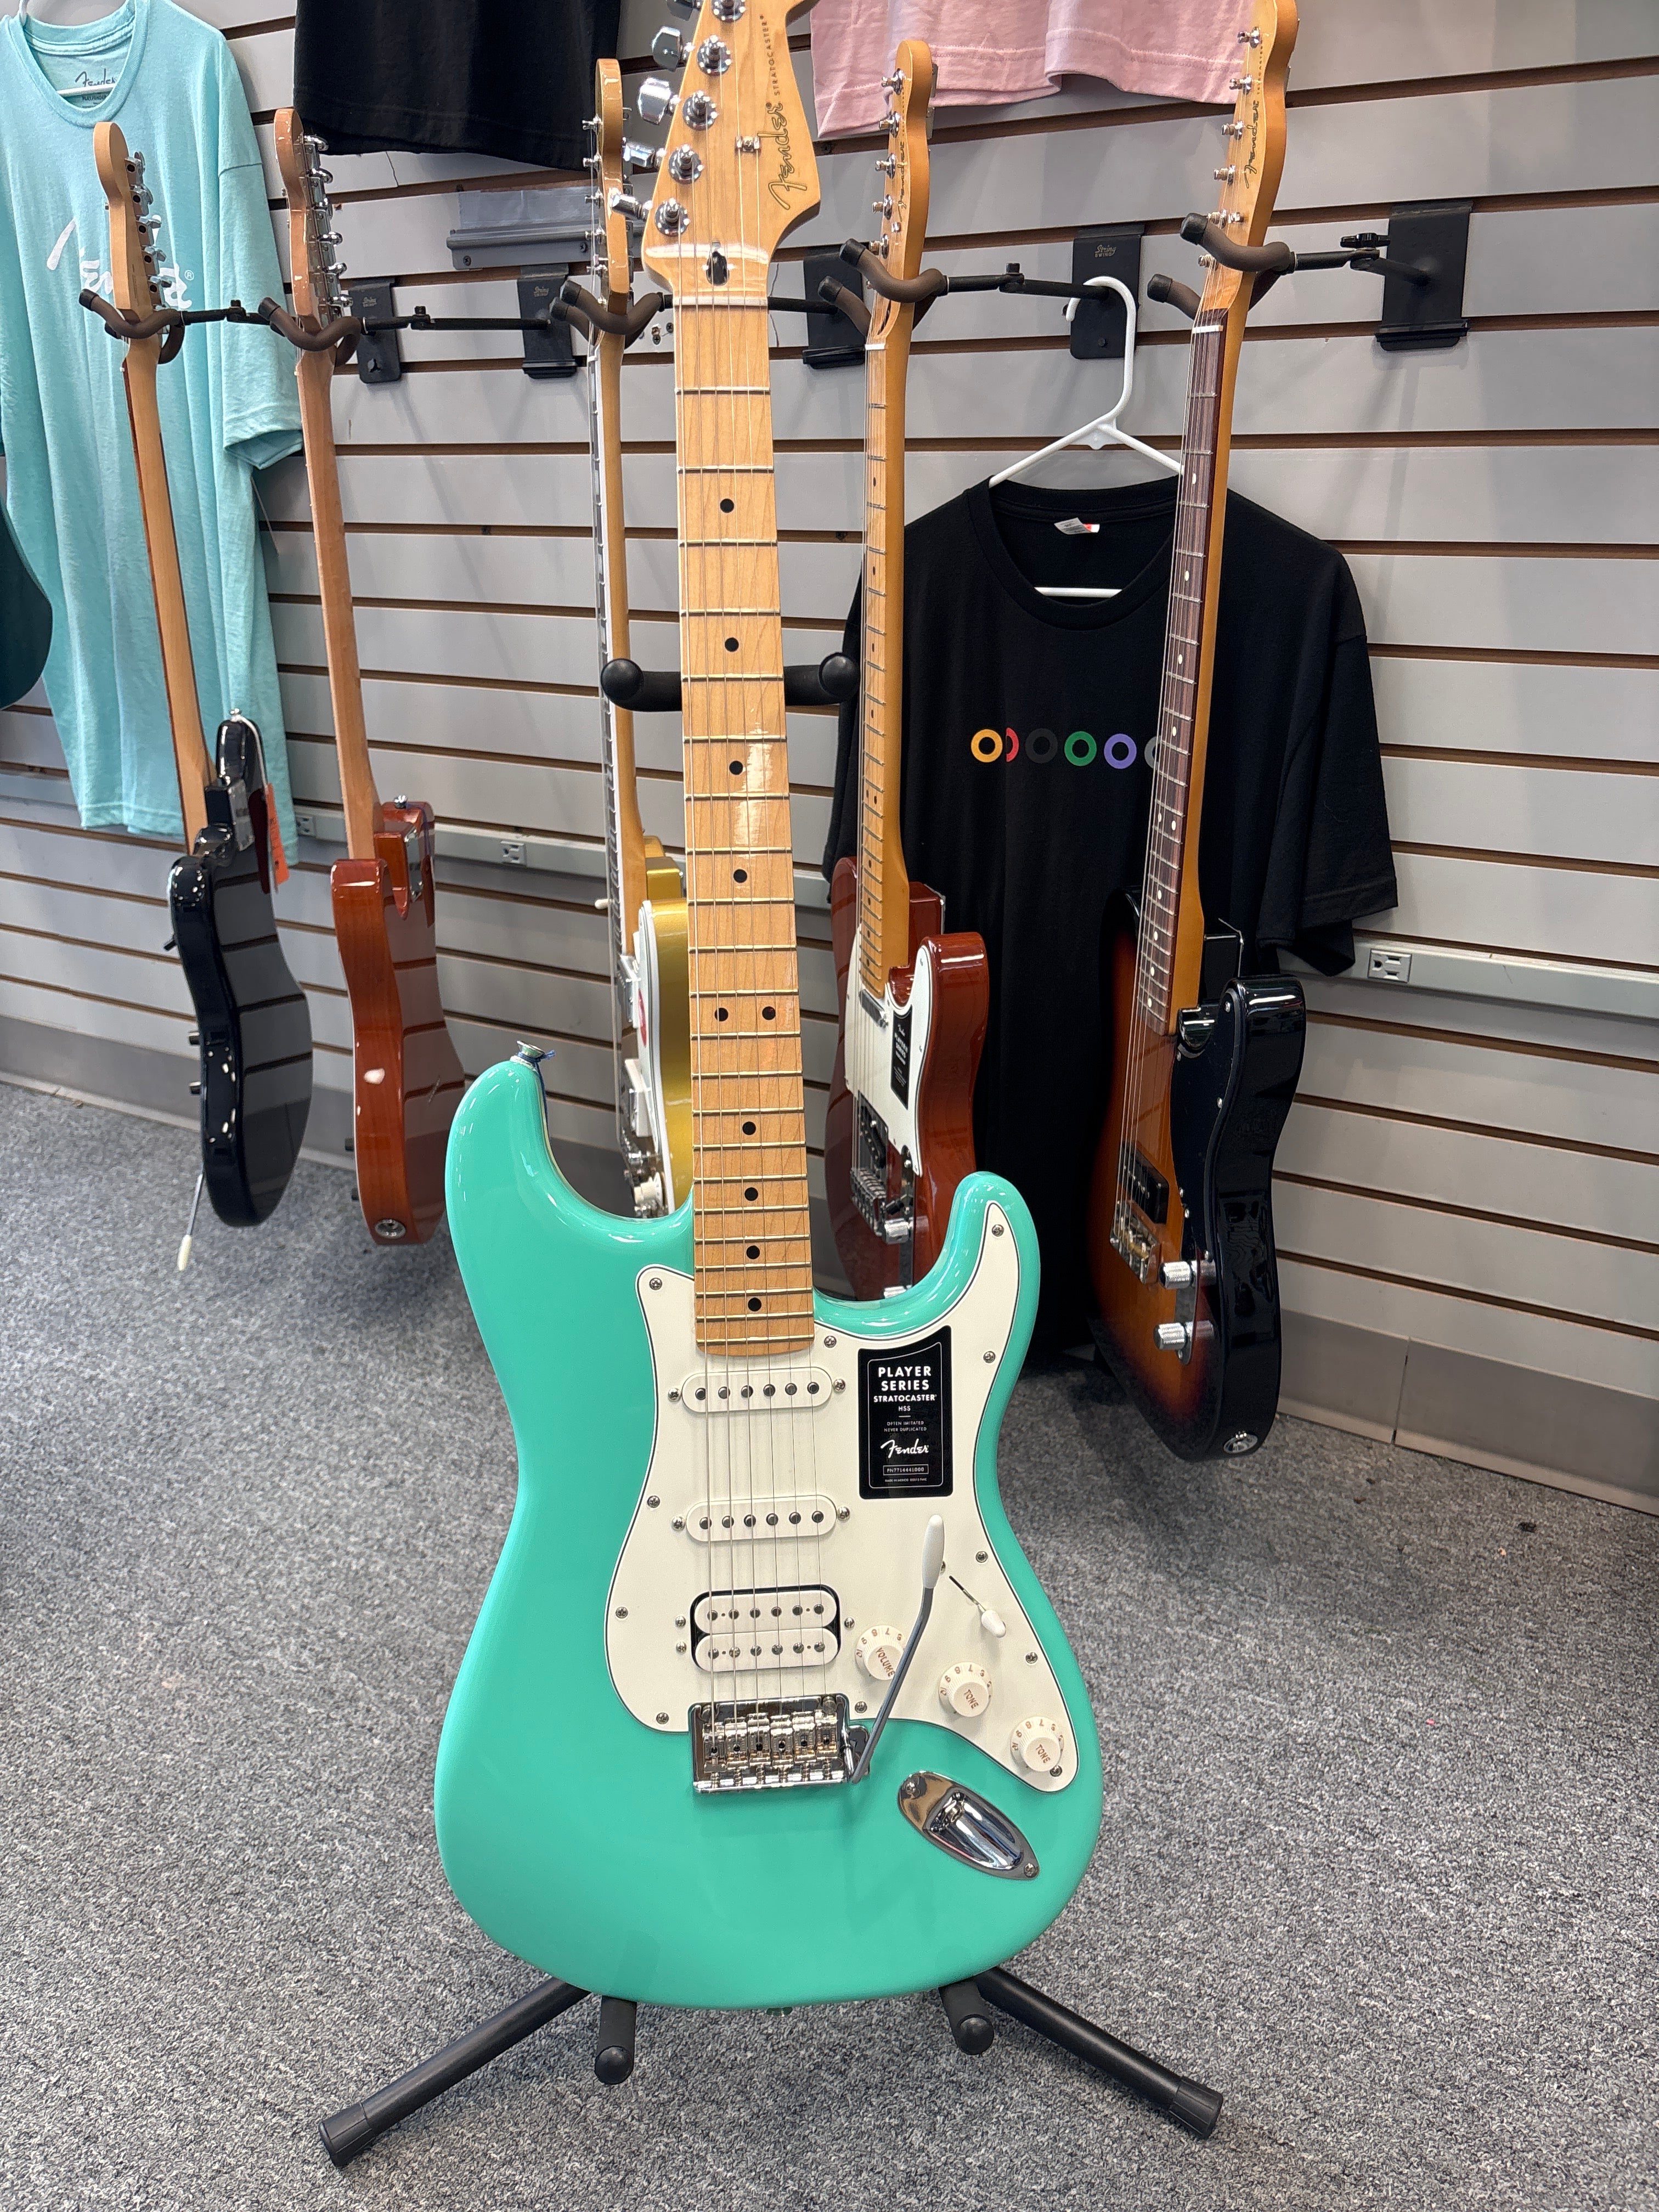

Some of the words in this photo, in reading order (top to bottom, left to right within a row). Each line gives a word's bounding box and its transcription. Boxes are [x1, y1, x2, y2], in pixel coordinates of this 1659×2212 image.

[878, 1365, 932, 1378] PLAYER
[881, 1379, 929, 1391] SERIES
[876, 1647, 896, 1677] VOLUME
[955, 1666, 961, 1674] 8
[968, 1664, 973, 1672] 7
[964, 1689, 979, 1709] TONE
[1025, 1721, 1032, 1729] 8
[1039, 1719, 1045, 1727] 7
[1036, 1744, 1051, 1764] TONE
